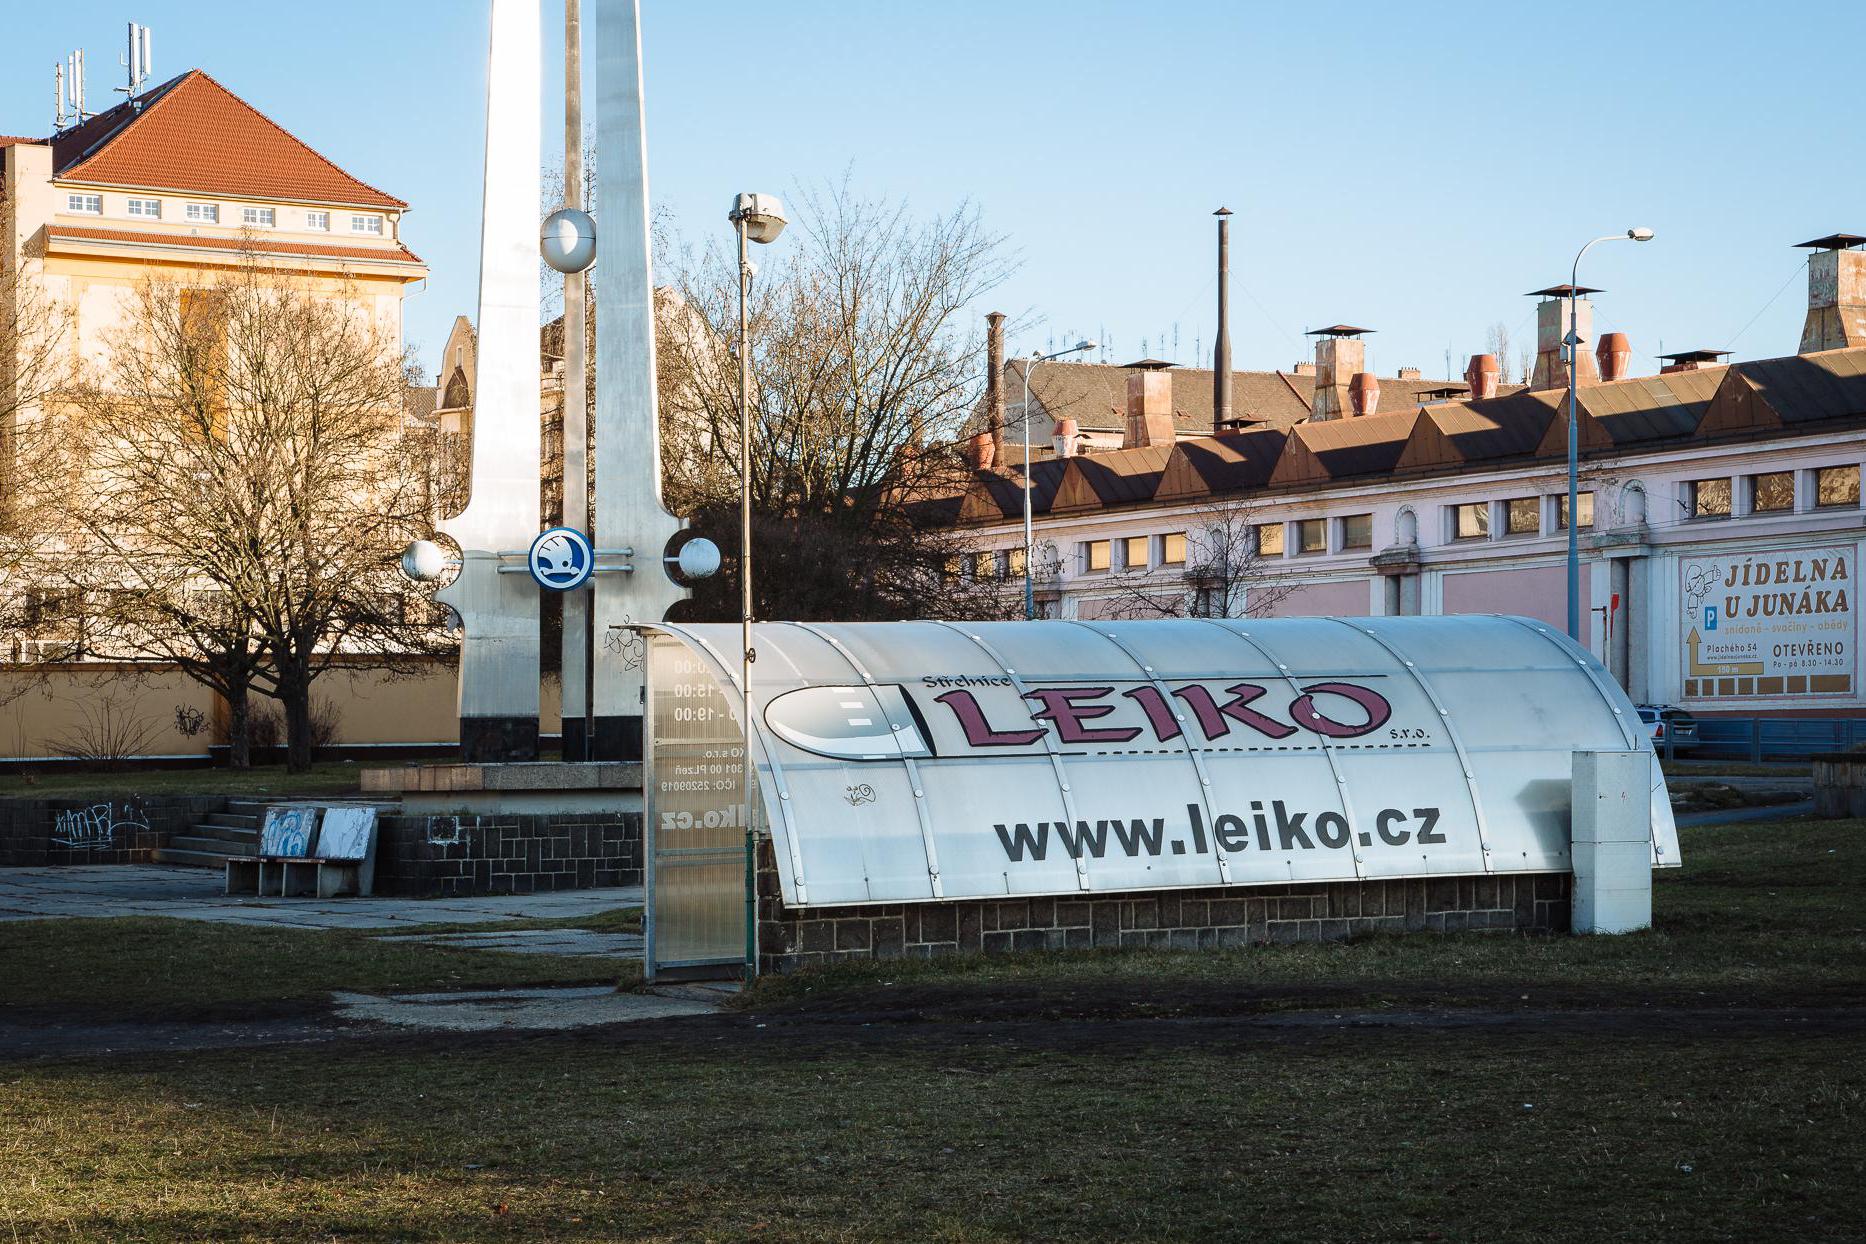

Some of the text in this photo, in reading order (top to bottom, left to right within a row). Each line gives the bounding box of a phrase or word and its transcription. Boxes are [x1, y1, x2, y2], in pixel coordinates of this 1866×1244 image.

[1724, 557, 1849, 588] JÍDELNA
[1725, 585, 1849, 618] U JUNÁKA
[1707, 610, 1715, 627] P
[1707, 643, 1757, 653] Plachého 54
[1773, 640, 1844, 658] OTEVŘENO
[1773, 660, 1782, 669] Po
[1824, 658, 1844, 667] 14.30
[921, 674, 1013, 689] Střelnice
[933, 682, 1430, 748] LEIKO s.r.o.
[993, 800, 1447, 862] www.leiko.cz
